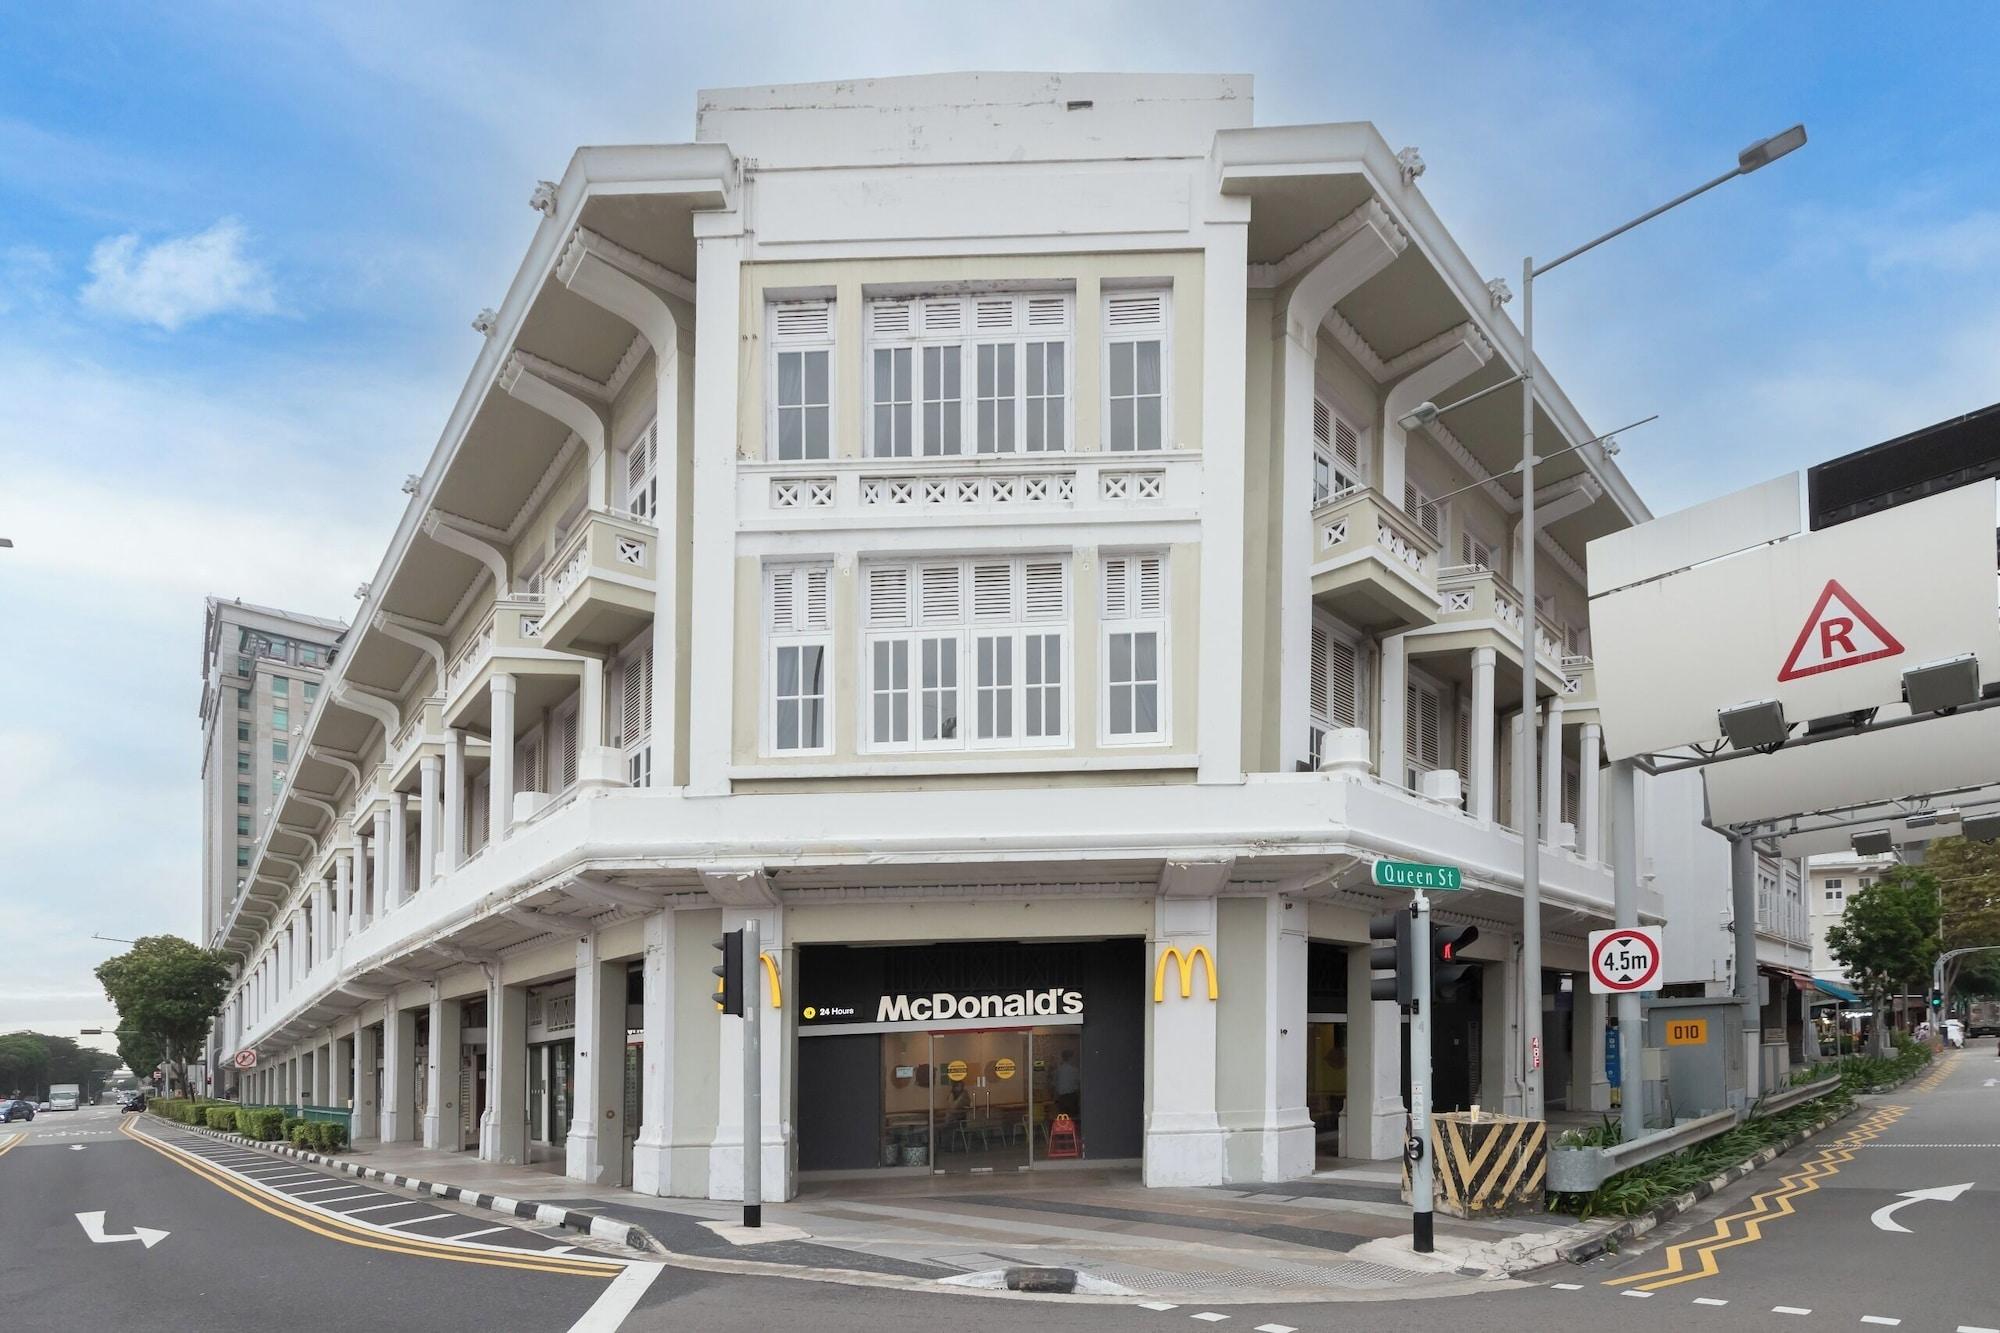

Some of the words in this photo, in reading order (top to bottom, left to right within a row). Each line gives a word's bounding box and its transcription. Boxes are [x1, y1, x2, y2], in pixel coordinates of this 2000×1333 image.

[1820, 617, 1857, 659] R
[1384, 864, 1433, 885] Queen
[1438, 868, 1454, 887] St
[1604, 950, 1647, 971] 4.5m
[819, 1007, 830, 1016] 24
[831, 1007, 854, 1016] Hours
[876, 988, 1083, 1022] McDonald's
[1674, 1025, 1699, 1040] 010
